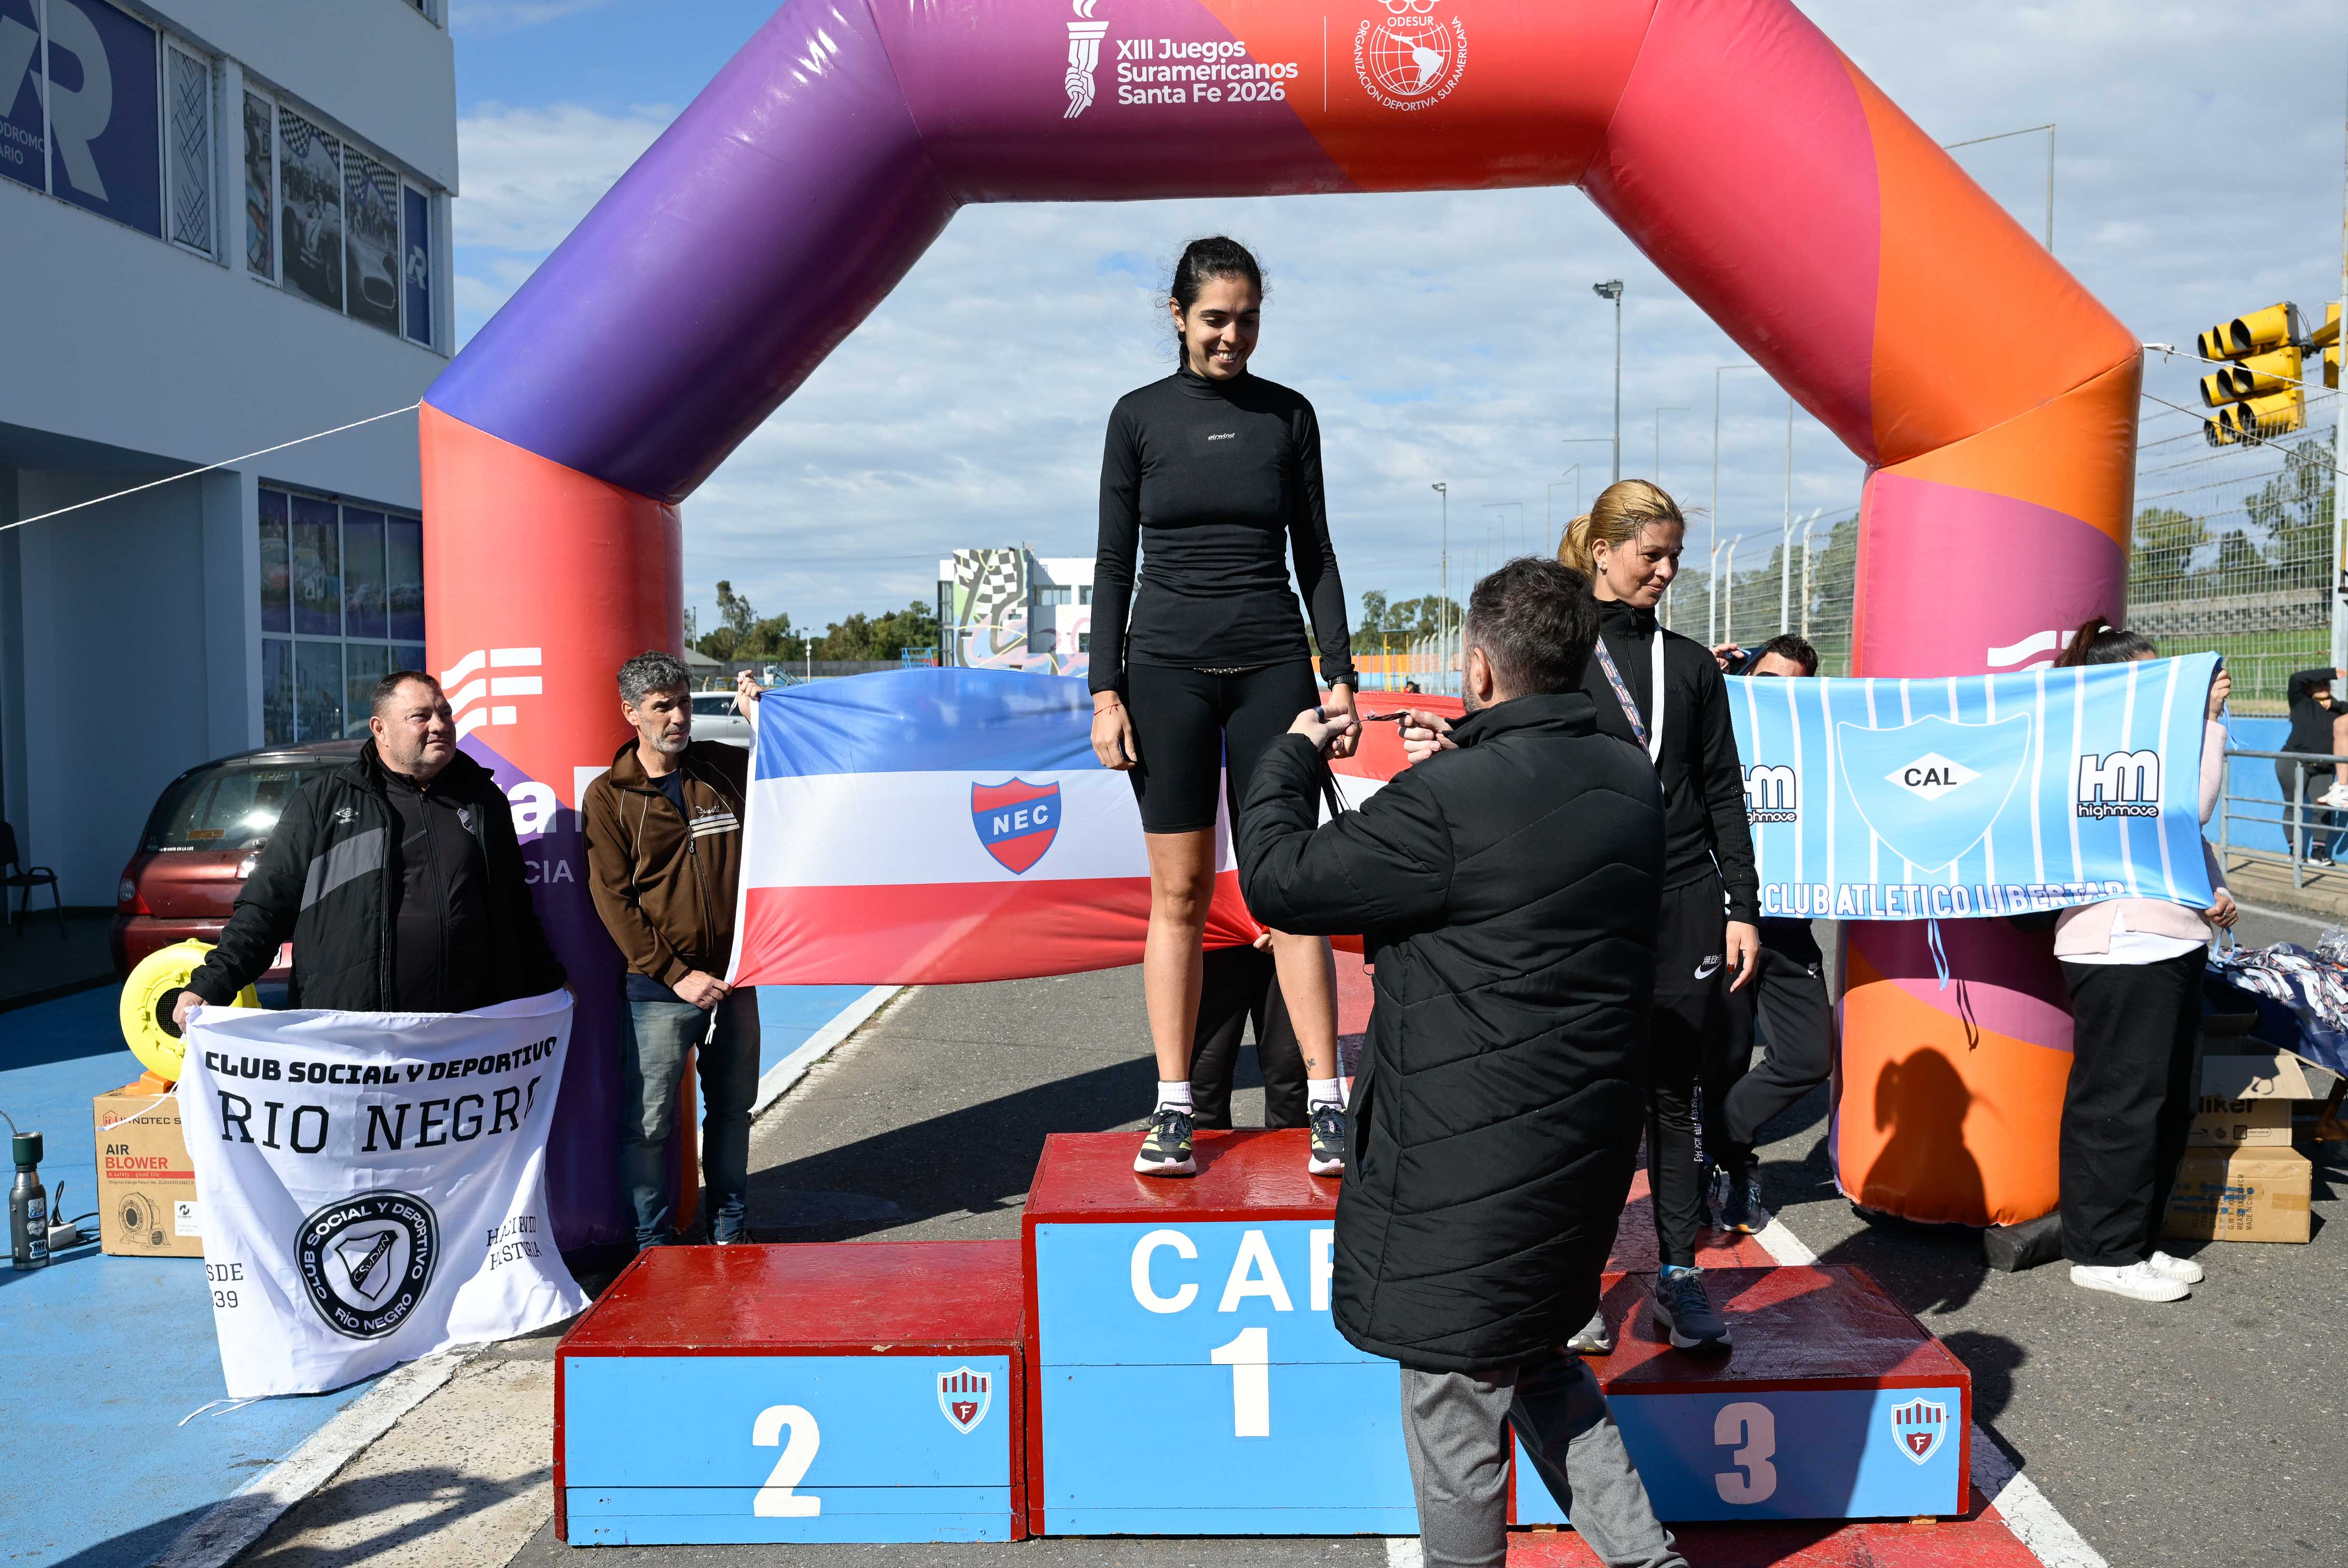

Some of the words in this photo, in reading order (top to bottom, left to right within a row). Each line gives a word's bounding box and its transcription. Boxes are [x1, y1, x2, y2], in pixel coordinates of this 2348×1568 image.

[1387, 16, 1434, 26] ODESUR
[1116, 39, 1153, 60] XIII
[1158, 38, 1246, 63] Juegos
[1353, 20, 1383, 102] ORGANIZACION
[1382, 96, 1439, 111] DEPORTIVA
[1437, 16, 1467, 99] SURAMERICANA
[1117, 58, 1298, 83] Suramericanos
[1118, 85, 1186, 104] Santa
[1193, 83, 1221, 102] Fe
[1227, 81, 1285, 102] 2026
[1904, 767, 1957, 786] CAL
[994, 805, 1049, 836] NEC
[1764, 883, 1829, 915] CLUB
[1835, 883, 1972, 917] ATLETICO
[205, 1051, 282, 1081] CLUB
[288, 1061, 400, 1085] SOCIAL
[407, 1064, 424, 1083] Y
[427, 1037, 557, 1081] DEPORTIVO
[217, 1089, 330, 1154] RIO
[105, 1156, 169, 1169] BLOWER
[106, 1144, 130, 1155] AIR
[376, 1202, 389, 1213] Y
[306, 1206, 372, 1247] SOCIAL
[391, 1202, 428, 1280] DEPORTIVO
[304, 1250, 327, 1299] CLUB
[209, 1289, 239, 1308] 39
[364, 1293, 412, 1331] NEGRO
[1210, 1327, 1270, 1437] 1
[959, 1405, 972, 1420] F
[1713, 1402, 1777, 1505] 3
[1913, 1436, 1927, 1451] F
[752, 1405, 821, 1517] 2
